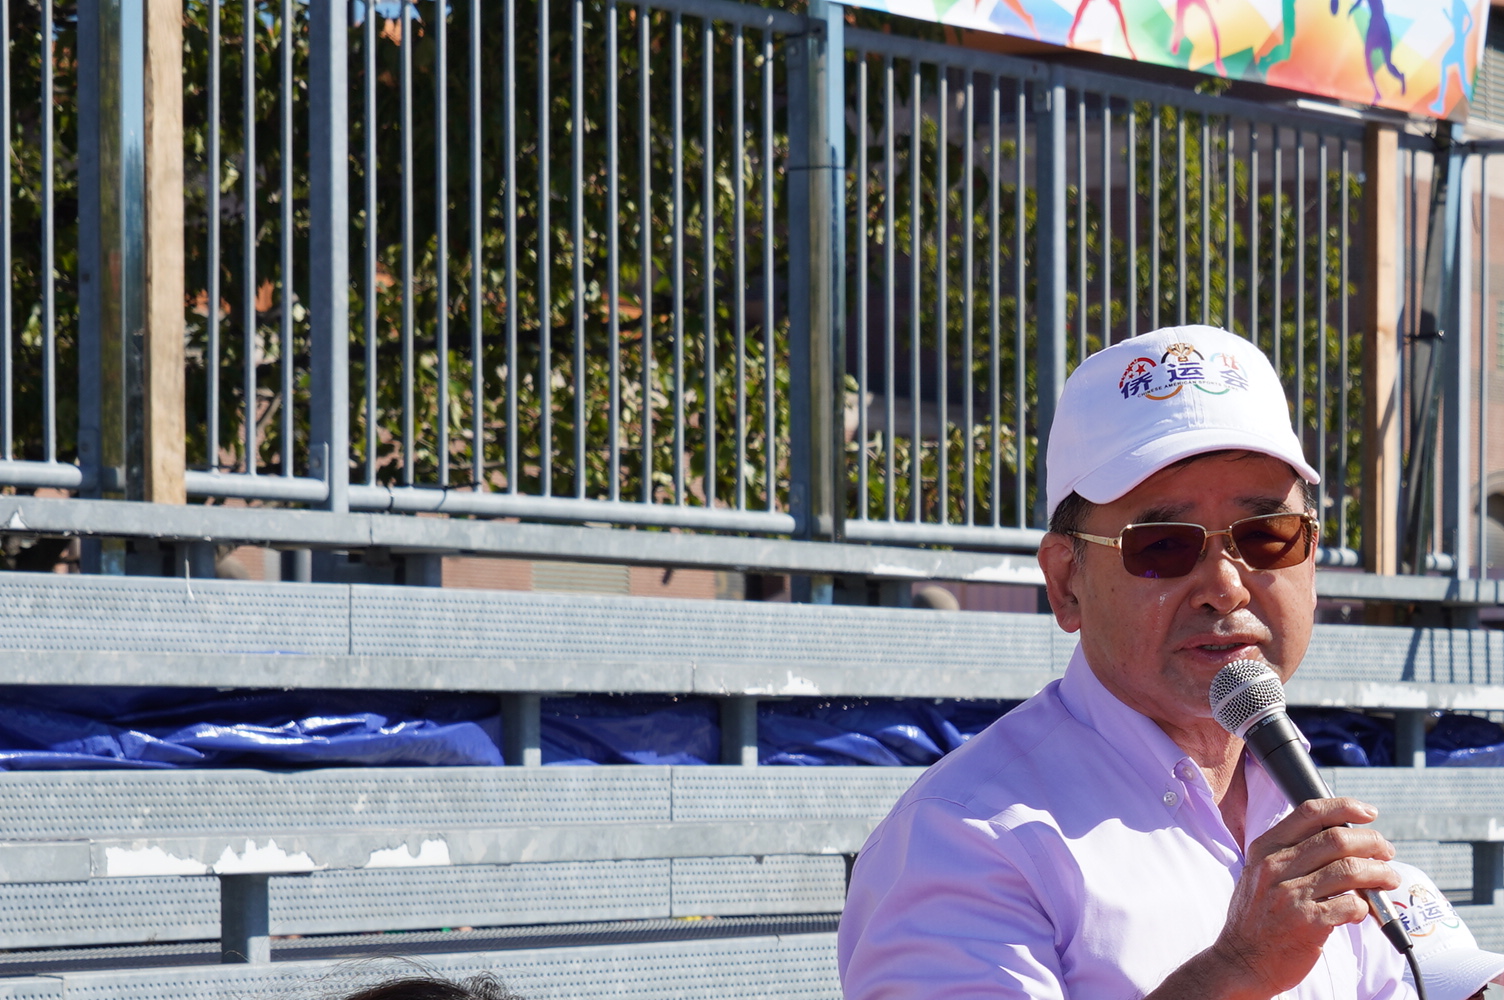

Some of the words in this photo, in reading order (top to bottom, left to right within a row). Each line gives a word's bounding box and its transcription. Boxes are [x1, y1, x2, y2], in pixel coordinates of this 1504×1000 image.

[1120, 362, 1249, 399] 侨运会
[1137, 384, 1163, 398] CHINESE
[1164, 379, 1197, 390] AMERICAN
